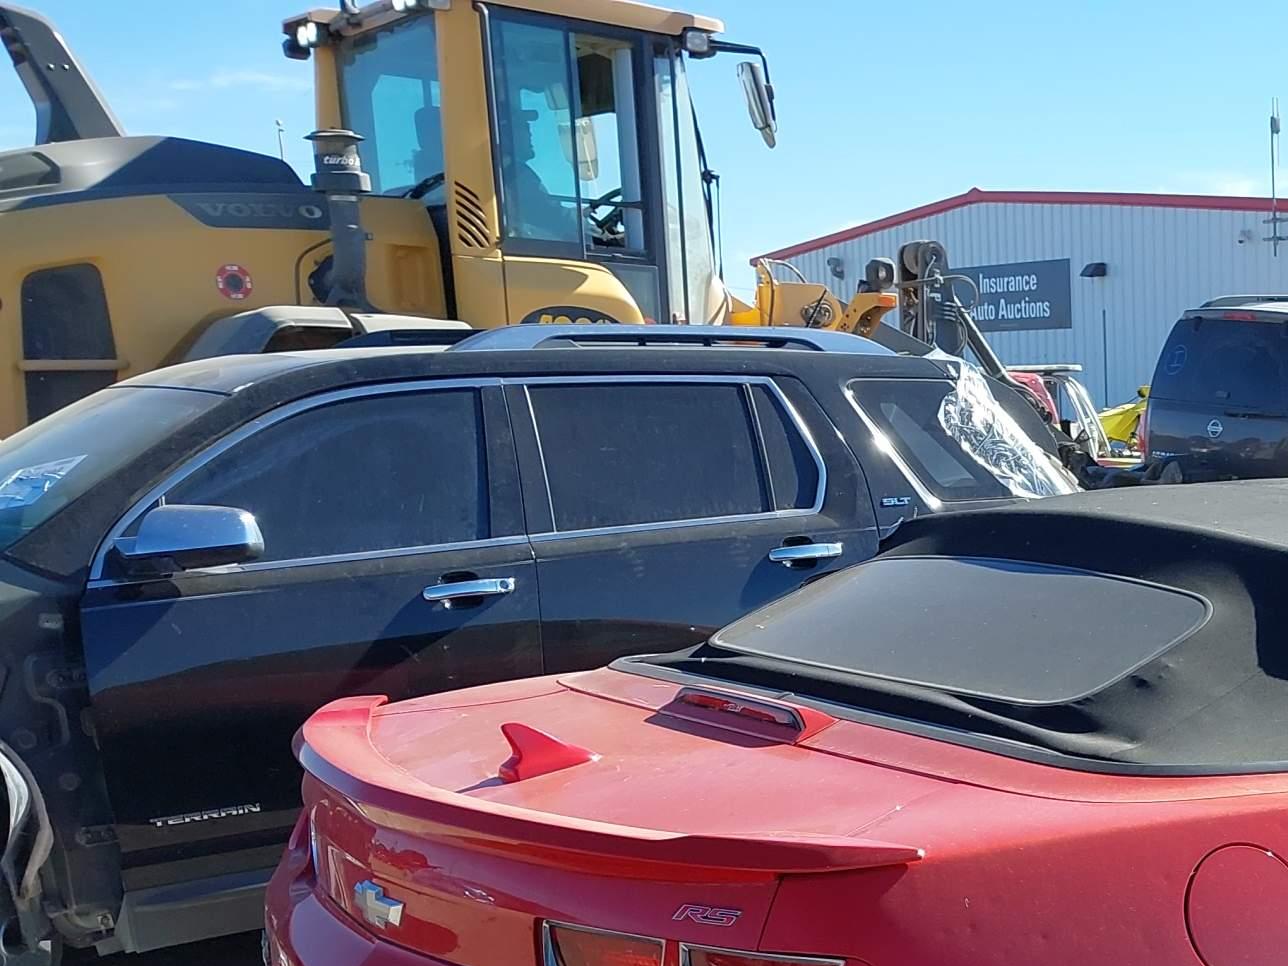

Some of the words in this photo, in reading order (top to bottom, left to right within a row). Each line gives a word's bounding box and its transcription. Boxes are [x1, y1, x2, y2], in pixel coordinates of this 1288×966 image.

[195, 203, 322, 219] VOLVO
[979, 273, 1038, 294] Insurance
[998, 297, 1050, 319] Auctions
[881, 496, 911, 506] SLT
[150, 803, 260, 827] TERRAIN
[672, 904, 742, 927] RS
